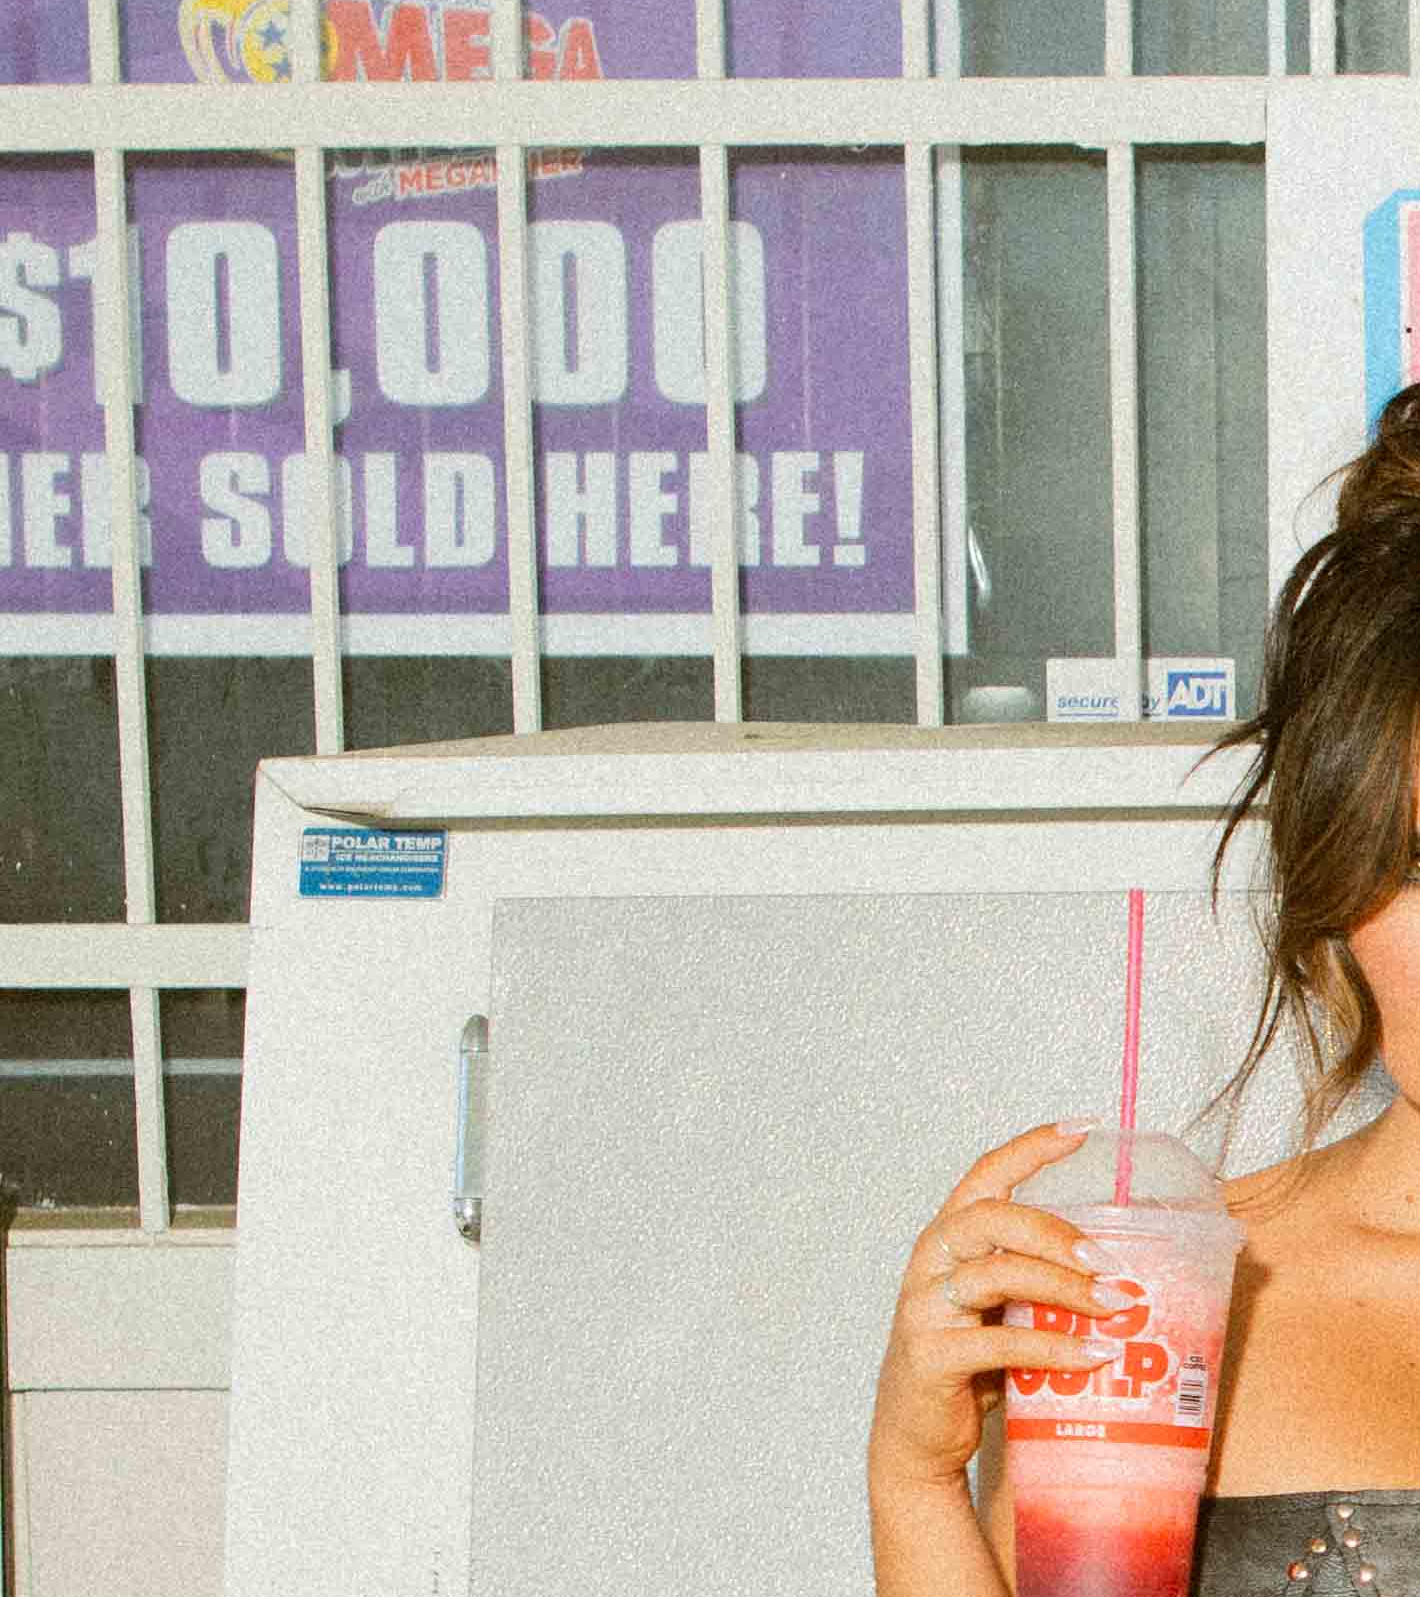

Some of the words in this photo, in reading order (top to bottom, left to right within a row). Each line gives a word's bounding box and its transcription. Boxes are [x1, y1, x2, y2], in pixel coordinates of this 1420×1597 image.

[398, 148, 584, 194] MEGAIER
[0, 452, 152, 568] ER
[200, 452, 497, 568] SOLD
[546, 450, 866, 567] HERE!
[1057, 693, 1120, 709] secure
[1168, 677, 1225, 710] ADT
[331, 835, 390, 850] POLAR
[396, 836, 443, 851] TEMP
